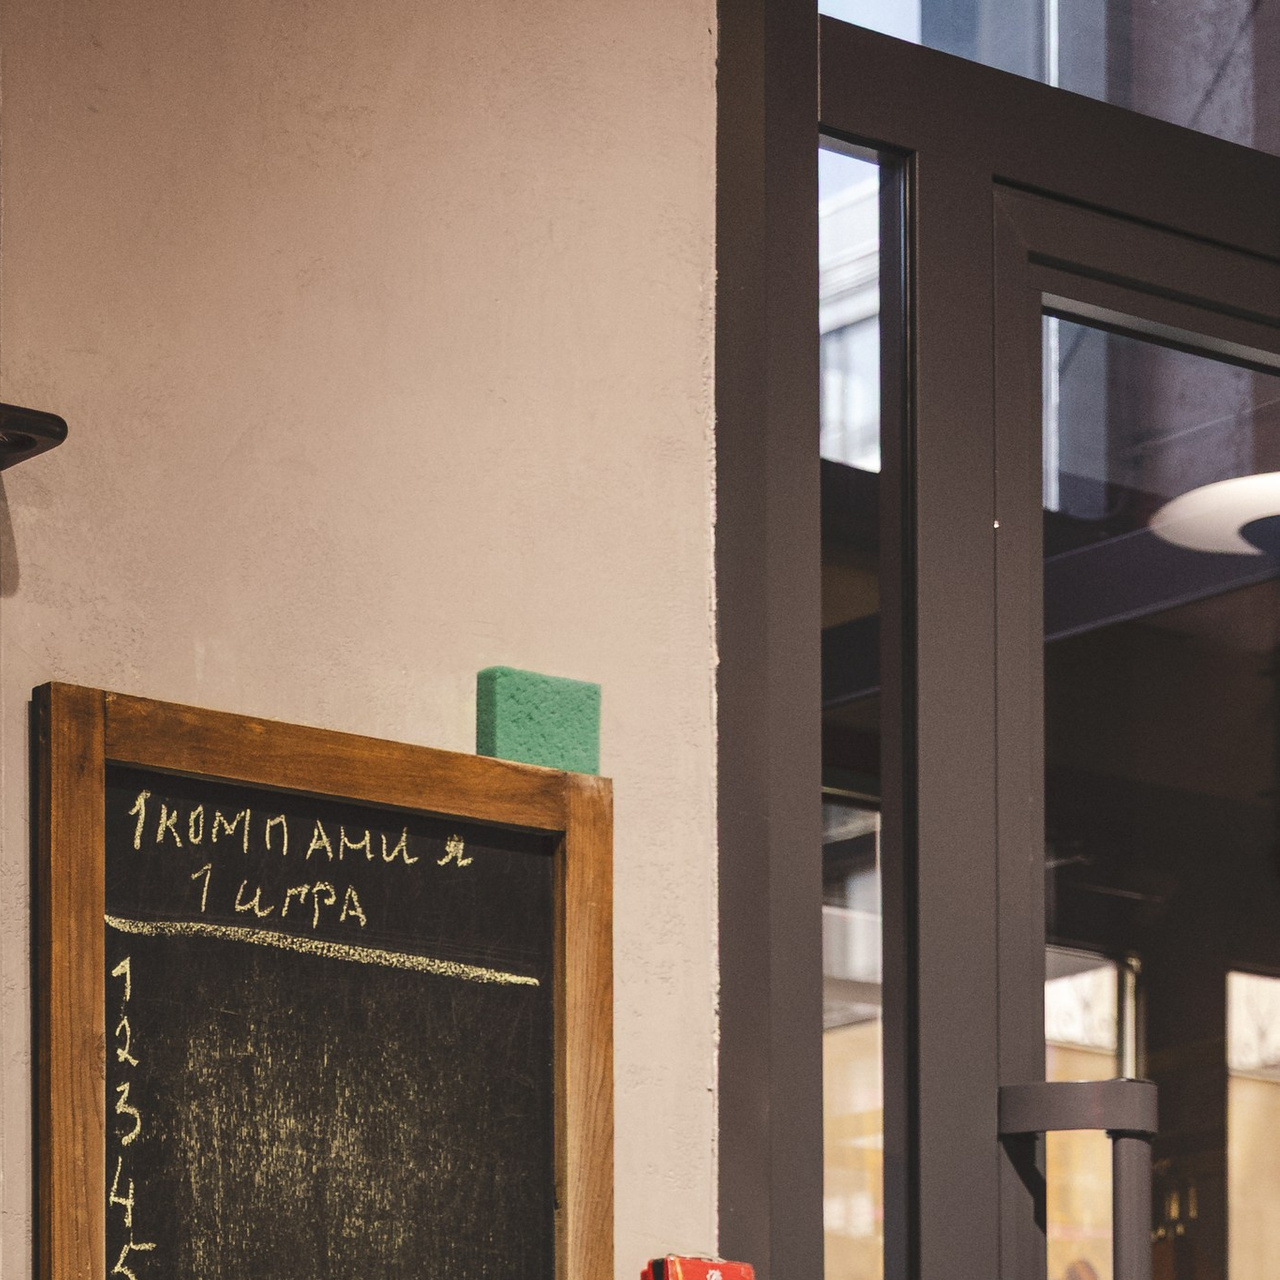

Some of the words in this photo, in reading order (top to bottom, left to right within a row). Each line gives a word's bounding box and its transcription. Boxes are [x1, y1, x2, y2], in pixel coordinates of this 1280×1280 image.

[190, 862, 213, 913] 1
[111, 956, 132, 1002] 1
[115, 1016, 139, 1066] 2
[114, 1081, 141, 1146] 3
[110, 1156, 136, 1228] 4
